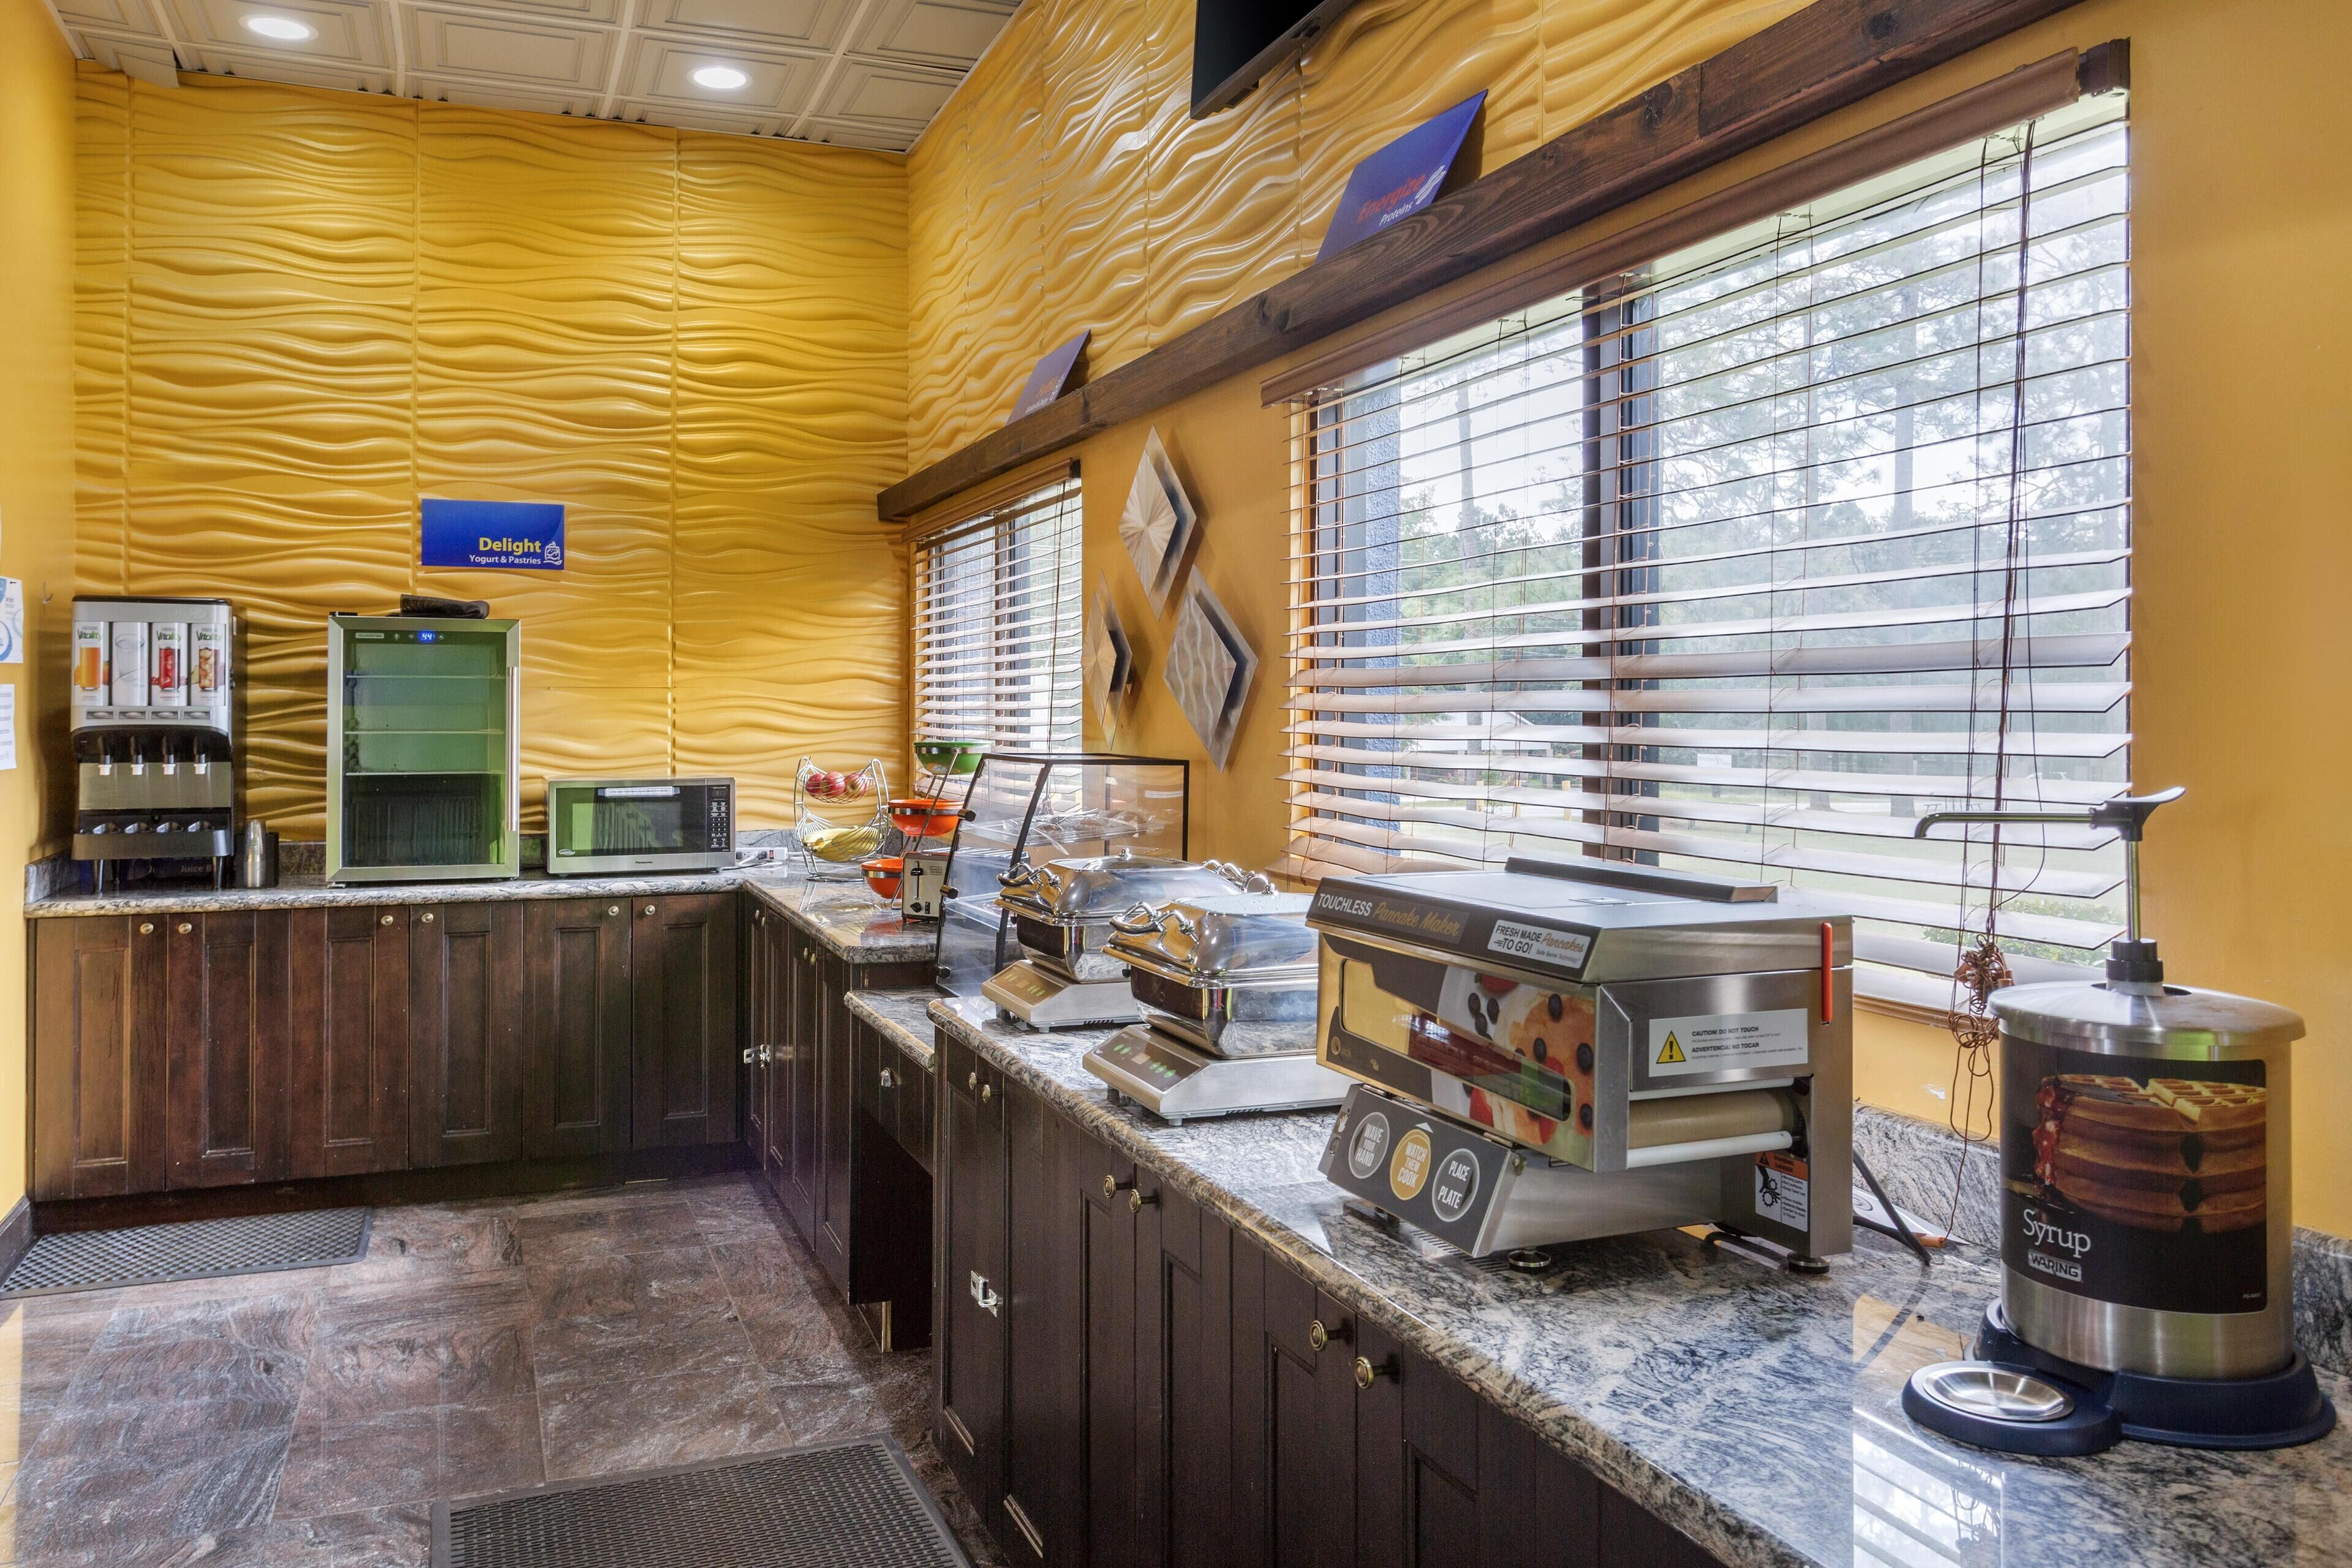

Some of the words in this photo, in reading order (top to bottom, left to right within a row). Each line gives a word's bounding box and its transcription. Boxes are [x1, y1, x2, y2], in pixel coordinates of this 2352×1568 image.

[1379, 202, 1413, 227] Proteins
[479, 537, 541, 555] Delight
[469, 555, 498, 564] Yogurt
[77, 629, 101, 641] Vitality
[1317, 894, 1372, 916] TOUCHLESS
[1372, 902, 1420, 927] Pancake
[1420, 911, 1460, 937] Maker
[1496, 925, 1520, 938] FRESH
[1520, 930, 1542, 942] MADE
[1541, 933, 1584, 952] Pancakes
[1502, 938, 1514, 950] TO
[1515, 943, 1532, 954] GO!
[1364, 1123, 1384, 1143] WAVE
[1363, 1139, 1376, 1152] YOUR
[1405, 1142, 1427, 1163] WATCH
[1355, 1148, 1374, 1166] HAND
[1405, 1158, 1420, 1172] THEM
[1397, 1168, 1419, 1188] COOK
[1448, 1161, 1470, 1182] PLACE
[1438, 1186, 1463, 1209] PLATE
[2024, 1209, 2090, 1258] Syrup
[2030, 1253, 2079, 1278] WARING
